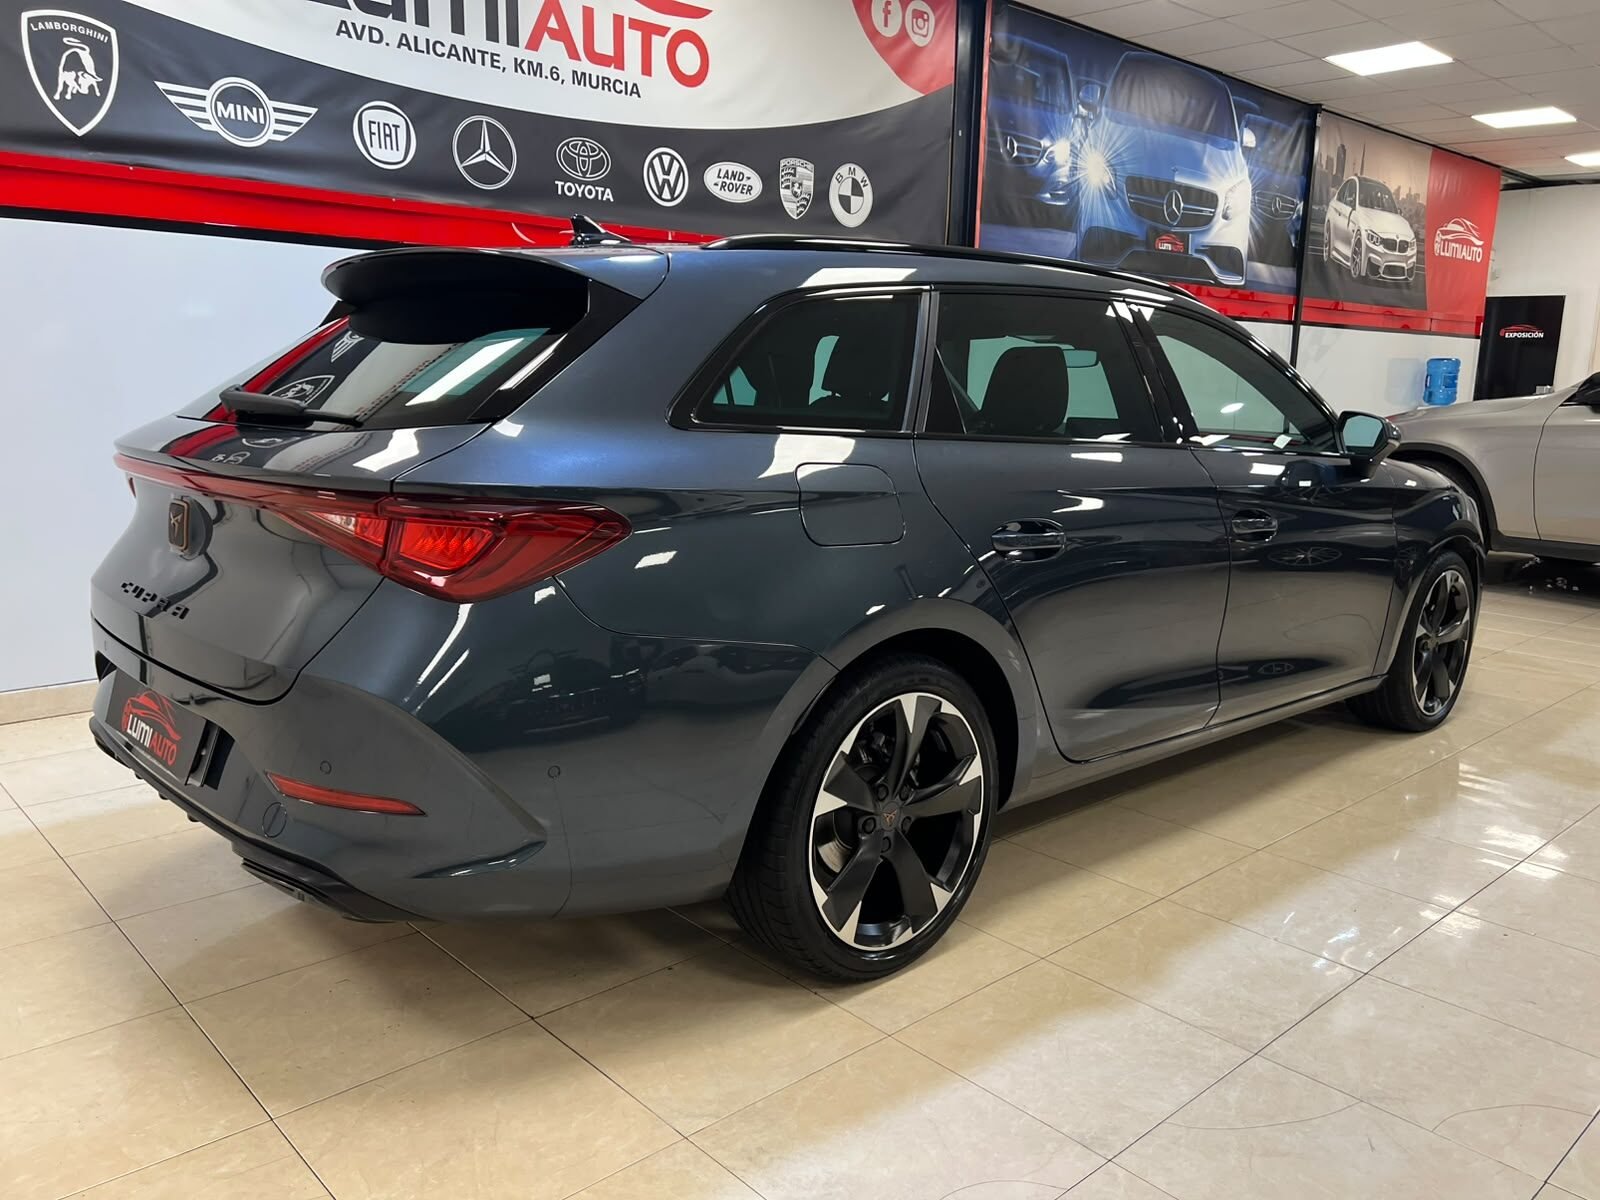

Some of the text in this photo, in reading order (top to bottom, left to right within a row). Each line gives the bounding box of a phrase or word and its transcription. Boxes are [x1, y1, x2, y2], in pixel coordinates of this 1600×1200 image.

[30, 21, 109, 43] LAMBORGHINI
[335, 19, 641, 98] AVD. ALICANTE, KM.6, MURCIA
[216, 101, 265, 125] MINI
[368, 119, 400, 152] FIAT
[716, 167, 745, 182] LAND
[554, 180, 614, 202] TOYOTA
[719, 181, 753, 196] ROVER
[1505, 331, 1544, 339] EXPOSICIÓN
